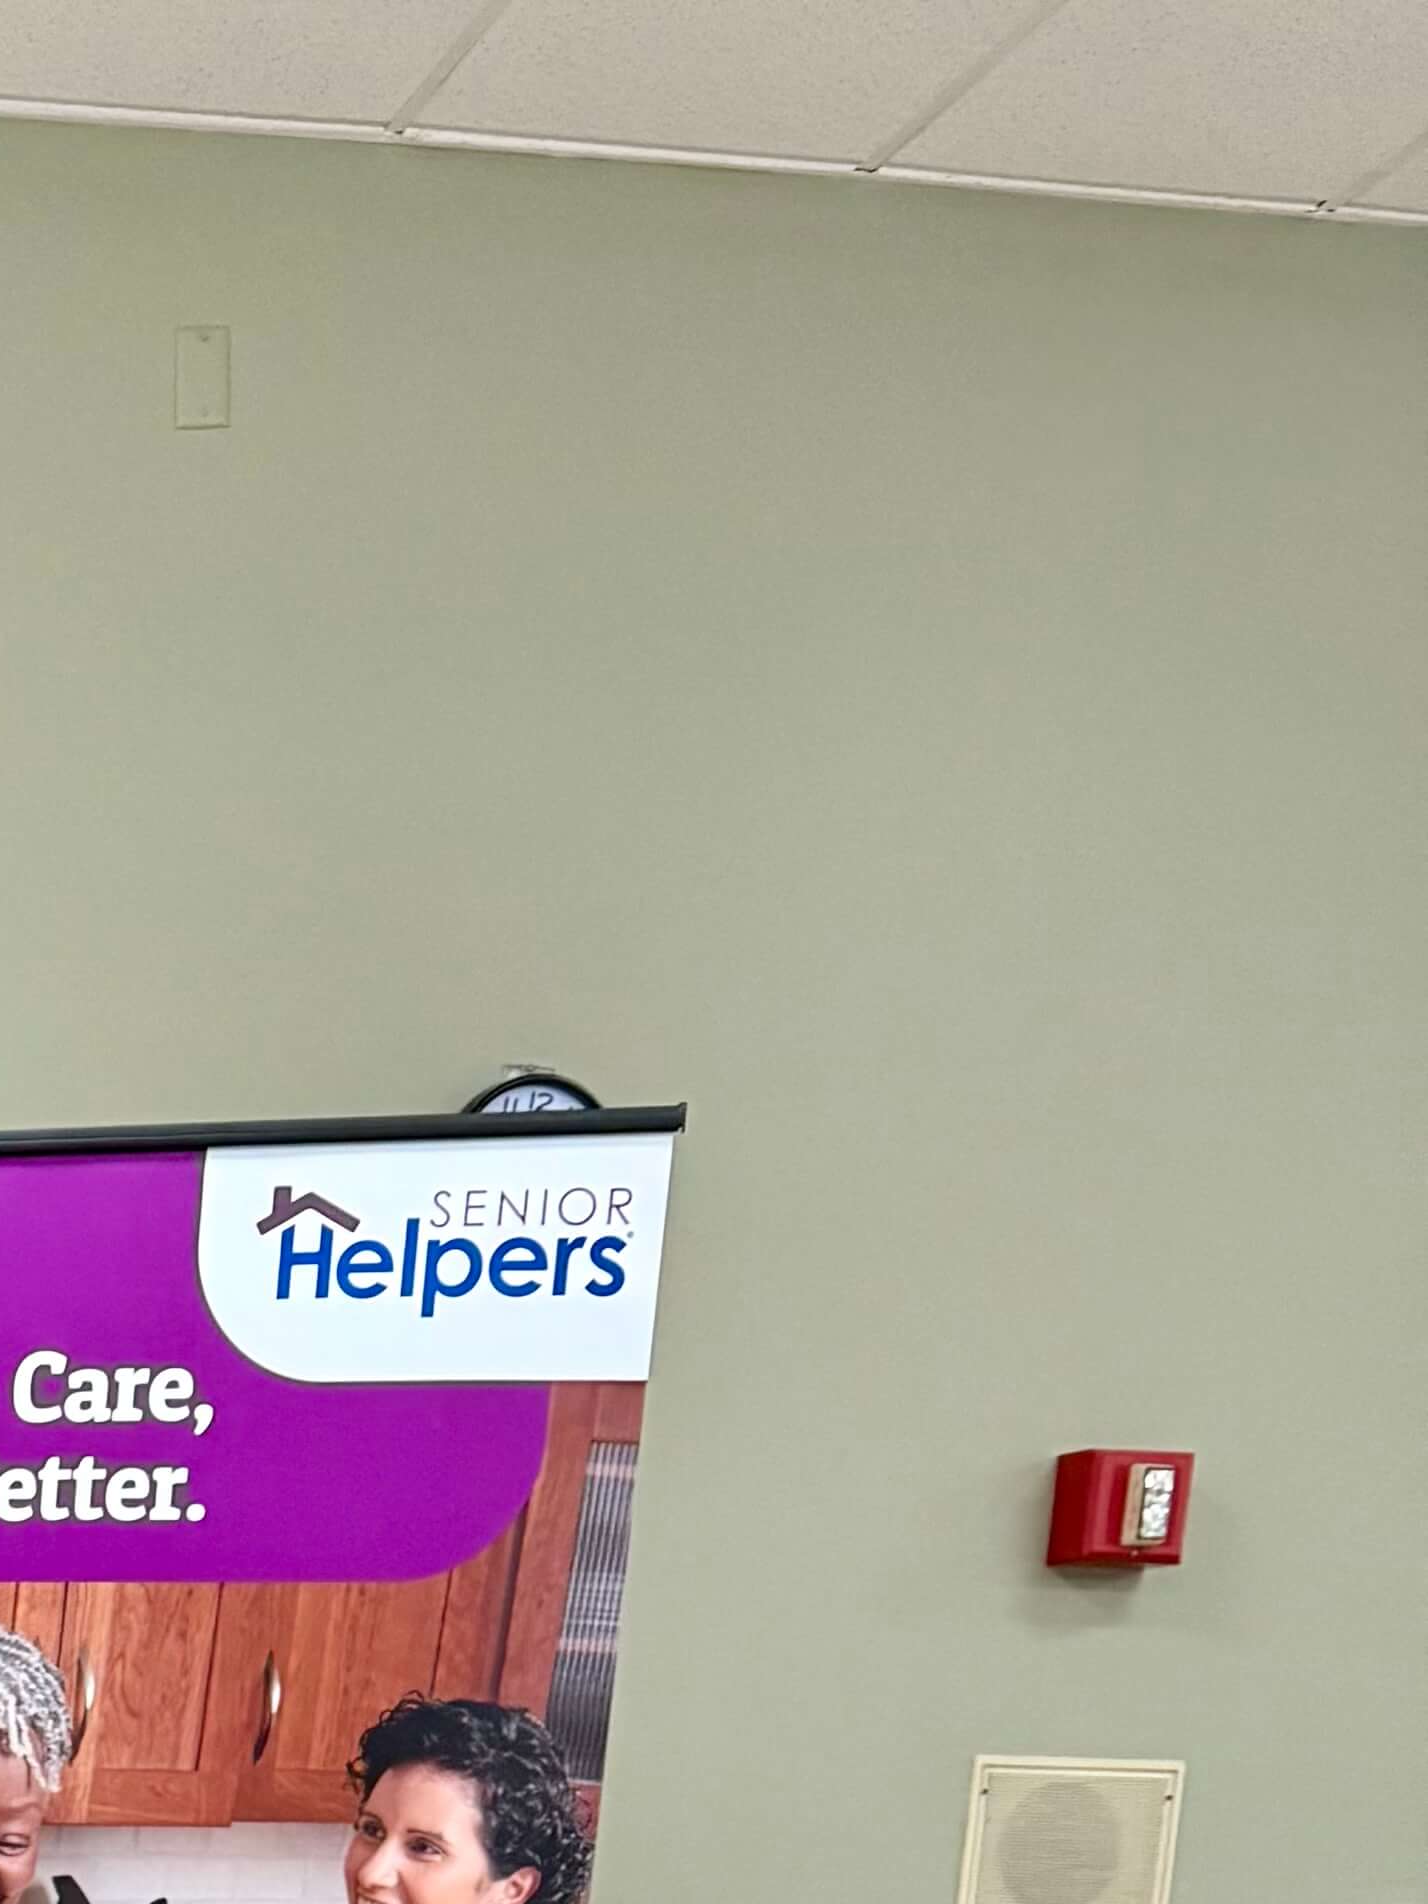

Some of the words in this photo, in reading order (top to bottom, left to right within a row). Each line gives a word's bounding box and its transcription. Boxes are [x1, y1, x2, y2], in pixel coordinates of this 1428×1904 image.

[430, 1186, 634, 1229] SENIOR
[275, 1217, 629, 1318] Helpers
[12, 1349, 216, 1437] Care,
